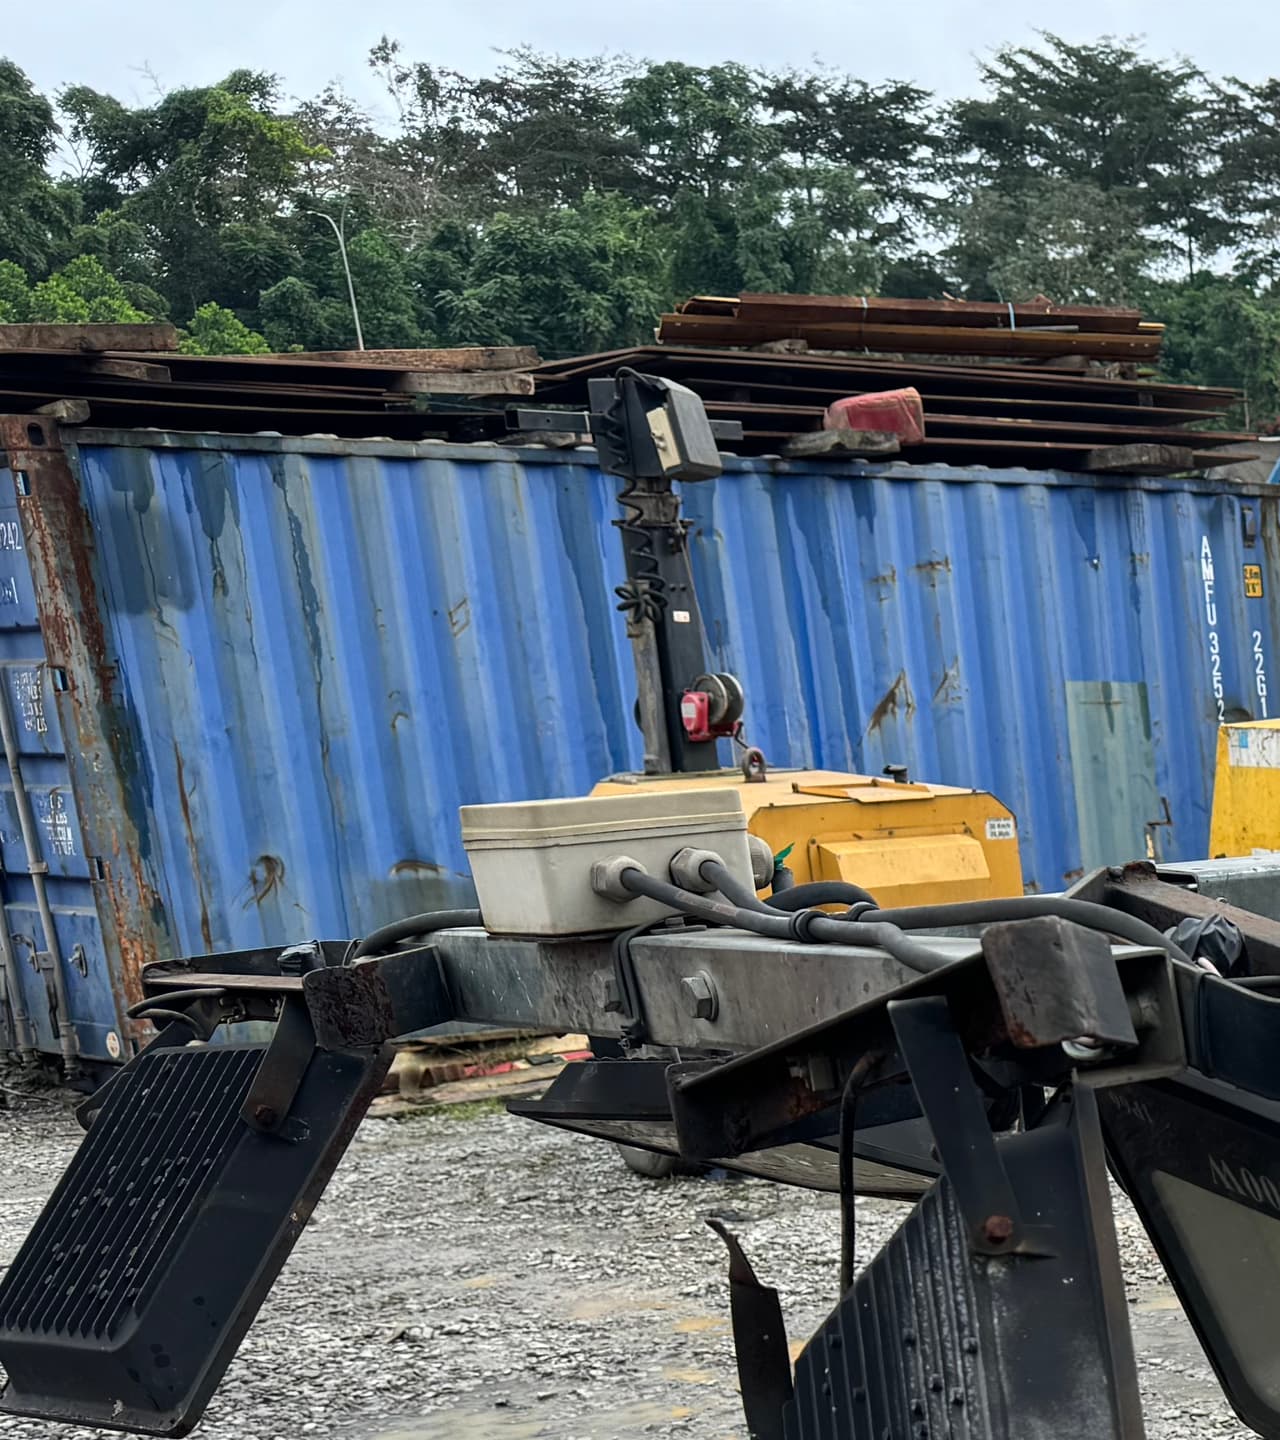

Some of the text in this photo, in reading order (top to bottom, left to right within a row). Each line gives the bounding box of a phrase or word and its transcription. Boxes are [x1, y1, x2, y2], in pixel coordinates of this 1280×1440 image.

[1201, 535, 1225, 726] AMFU 3252
[1252, 630, 1267, 718] 22G1
